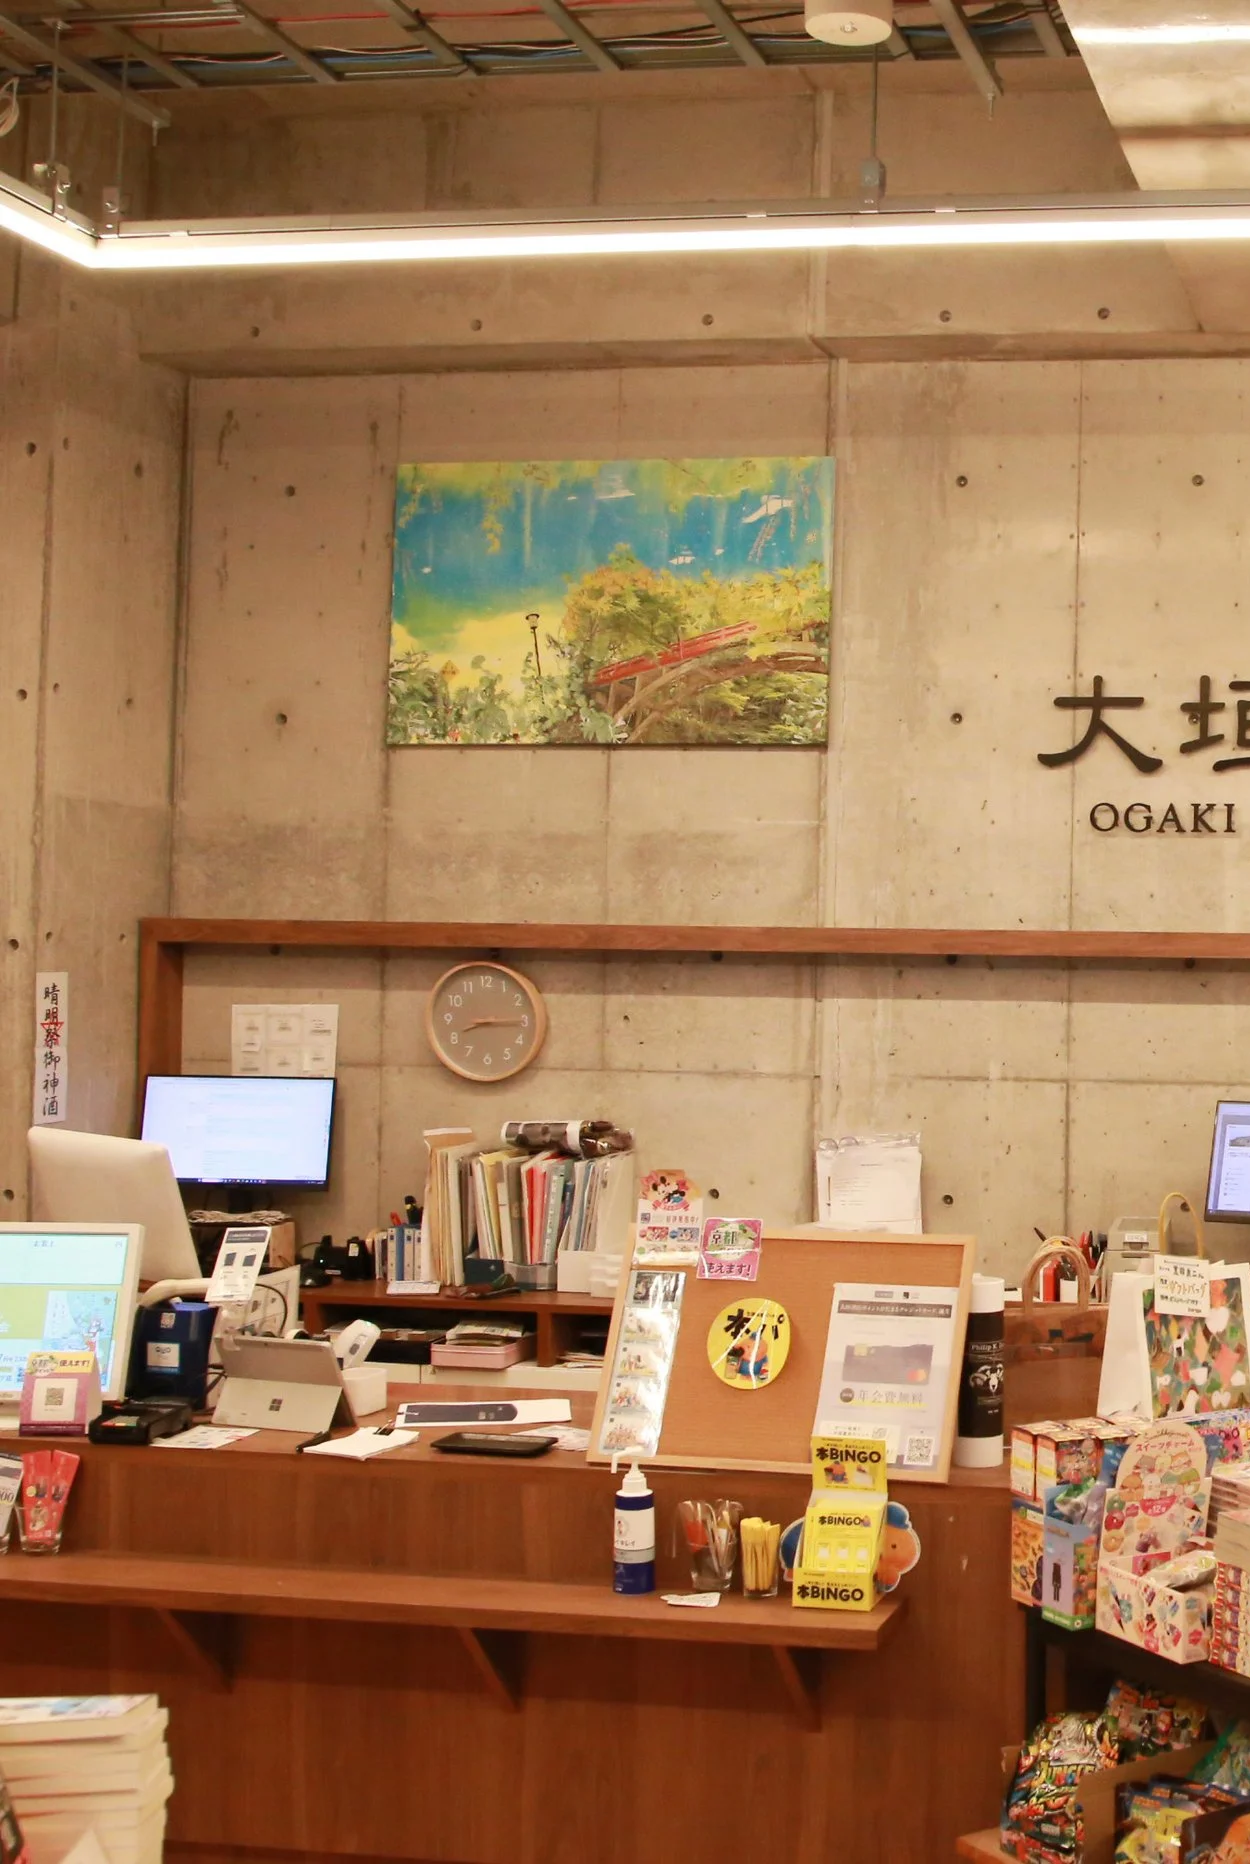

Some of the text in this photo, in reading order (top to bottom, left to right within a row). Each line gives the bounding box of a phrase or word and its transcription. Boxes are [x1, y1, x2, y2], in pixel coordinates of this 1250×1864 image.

[1089, 802, 1236, 834] OGAKI
[463, 981, 473, 993] 11
[480, 975, 493, 988] 12
[502, 980, 506, 992] 1
[448, 994, 462, 1007] 10
[514, 994, 522, 1006] 2
[444, 1013, 452, 1025] 9
[521, 1015, 529, 1027] 3
[450, 1032, 458, 1045] 8
[515, 1034, 523, 1045] 4
[465, 1045, 473, 1056] 7
[503, 1048, 511, 1060] 5
[483, 1053, 492, 1065] 6
[816, 1446, 882, 1464] 本BINGO
[818, 1515, 863, 1526] 本BINGO
[796, 1584, 864, 1602] 本BINGO
